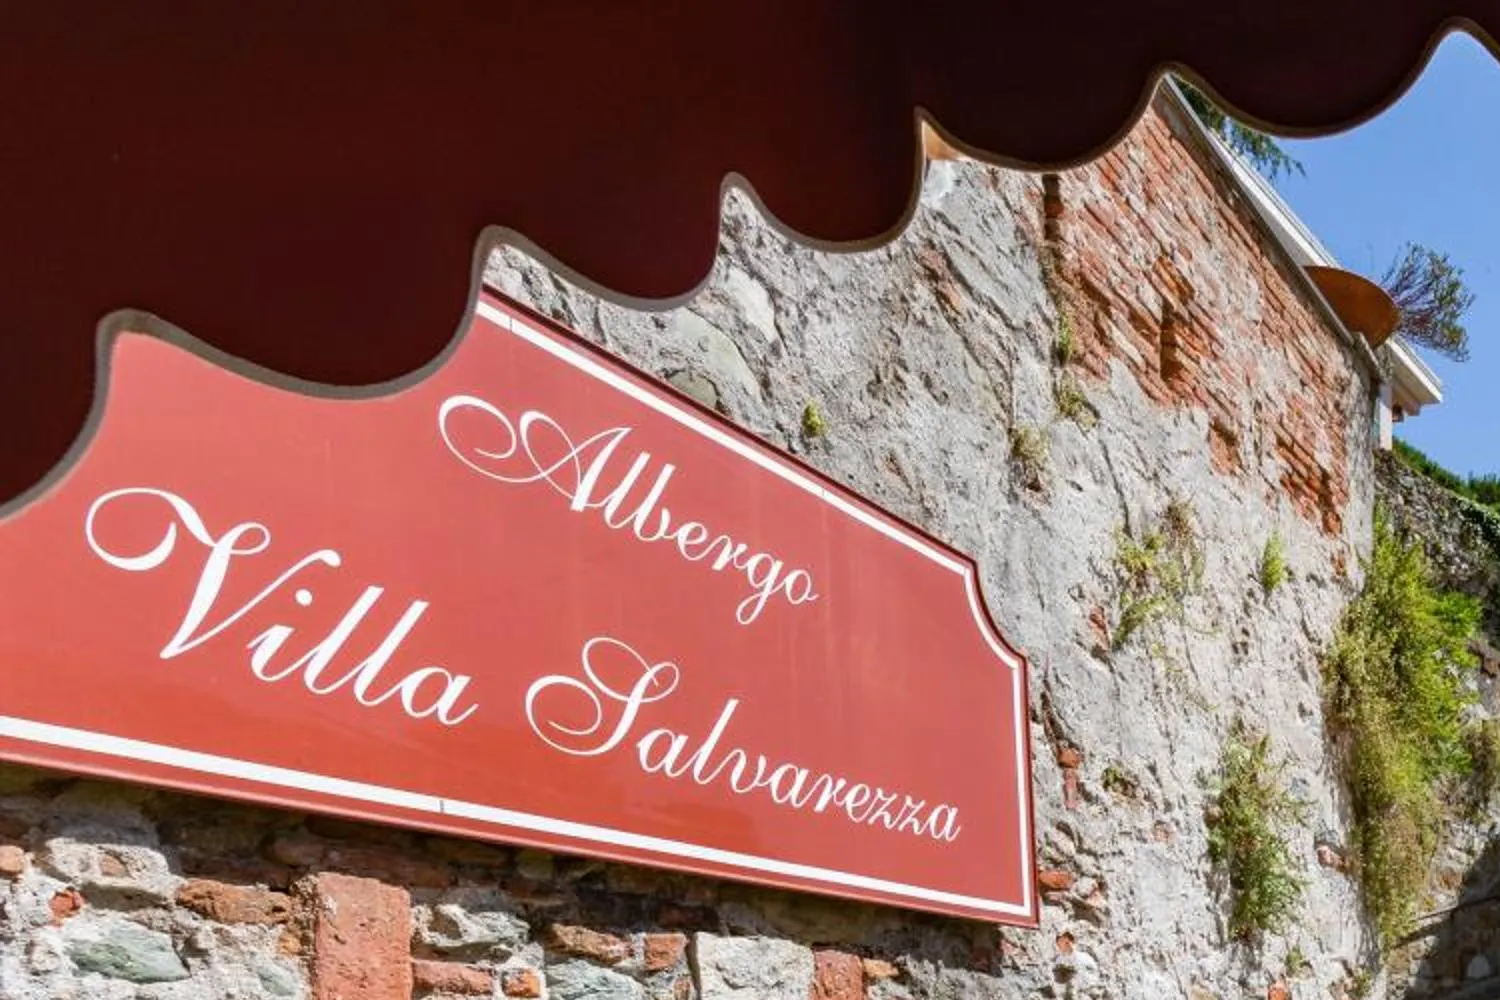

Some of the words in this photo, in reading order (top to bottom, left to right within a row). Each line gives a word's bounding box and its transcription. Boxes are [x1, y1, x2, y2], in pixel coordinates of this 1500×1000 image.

[437, 394, 819, 625] Albergo
[84, 487, 479, 726] Villa
[525, 636, 962, 842] Salvarezza
